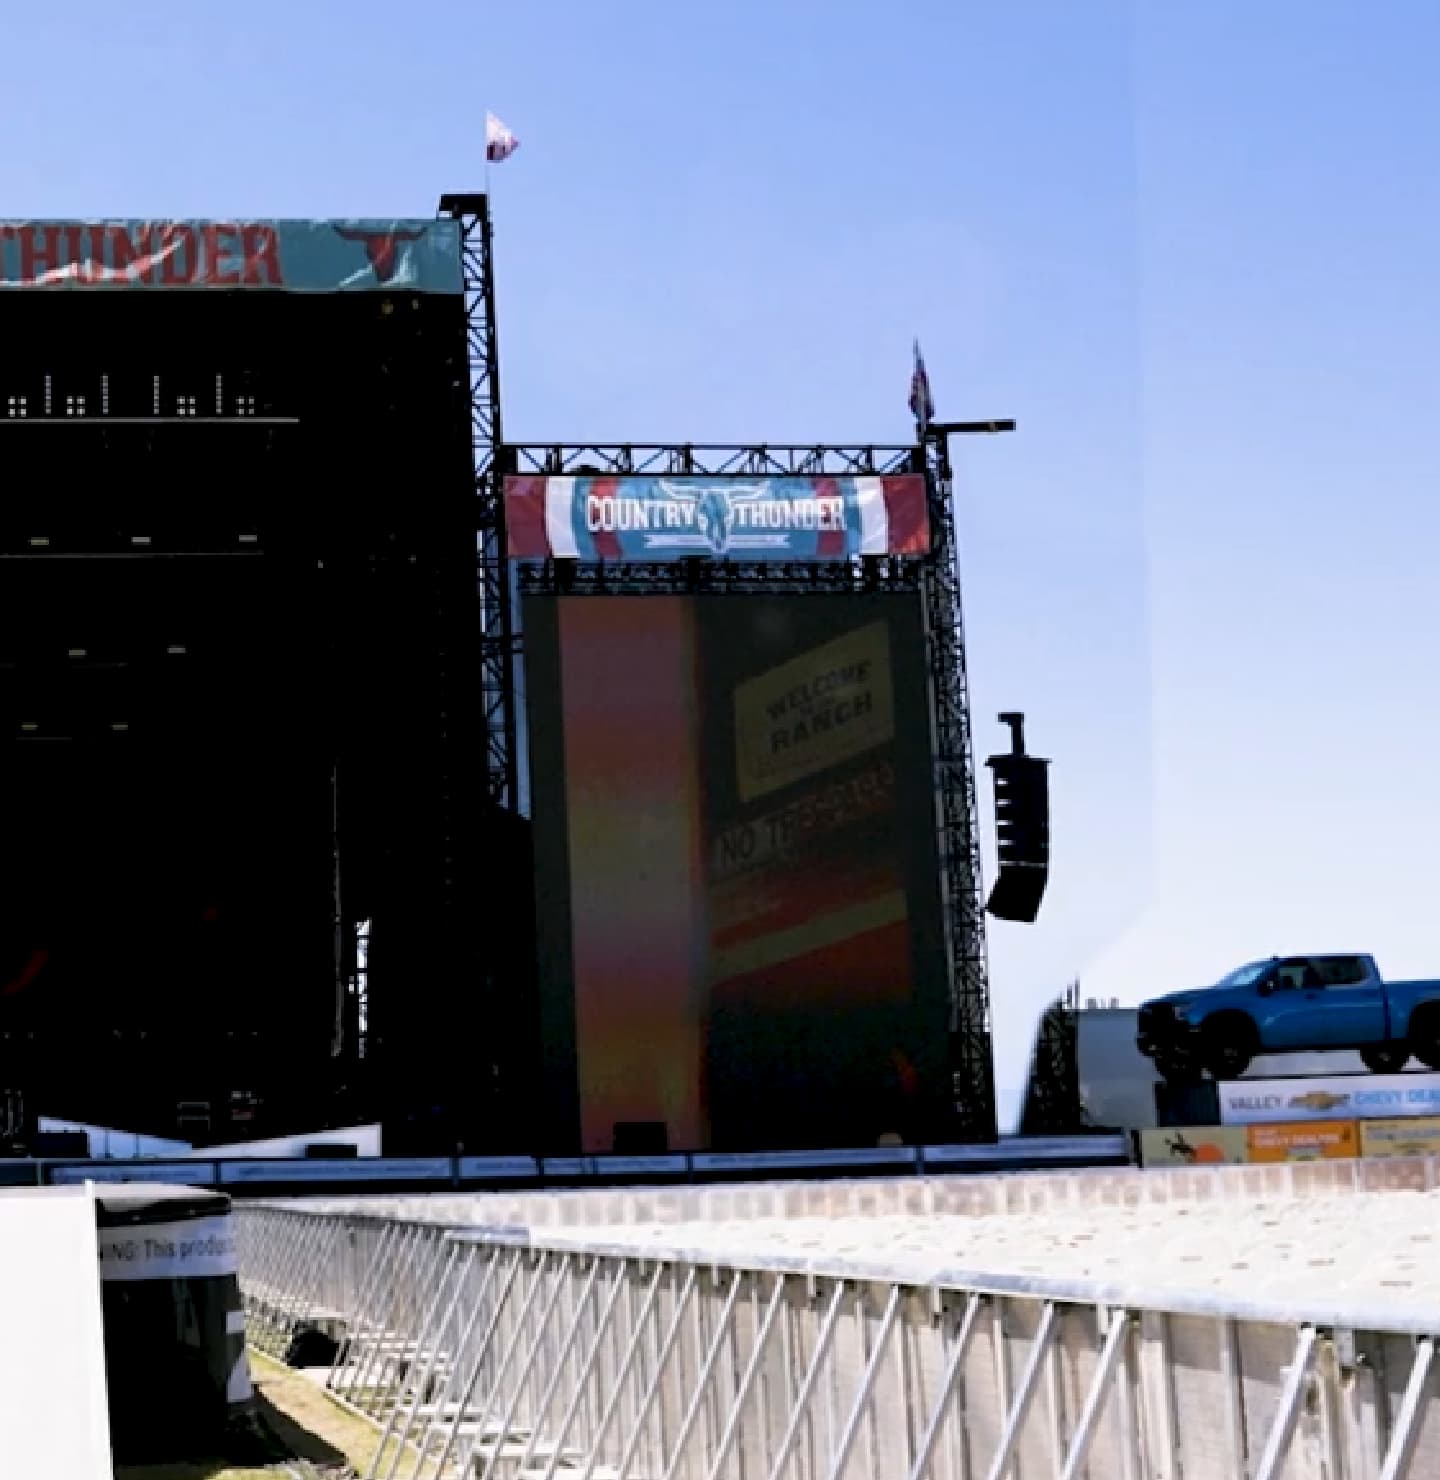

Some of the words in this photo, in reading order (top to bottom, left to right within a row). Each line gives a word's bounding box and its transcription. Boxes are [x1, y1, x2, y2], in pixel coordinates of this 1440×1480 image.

[587, 494, 696, 531] COUNTRY
[733, 494, 846, 531] THUNDER
[765, 659, 873, 721] WELCOME
[771, 691, 873, 754] RANCH
[720, 822, 756, 868] NO
